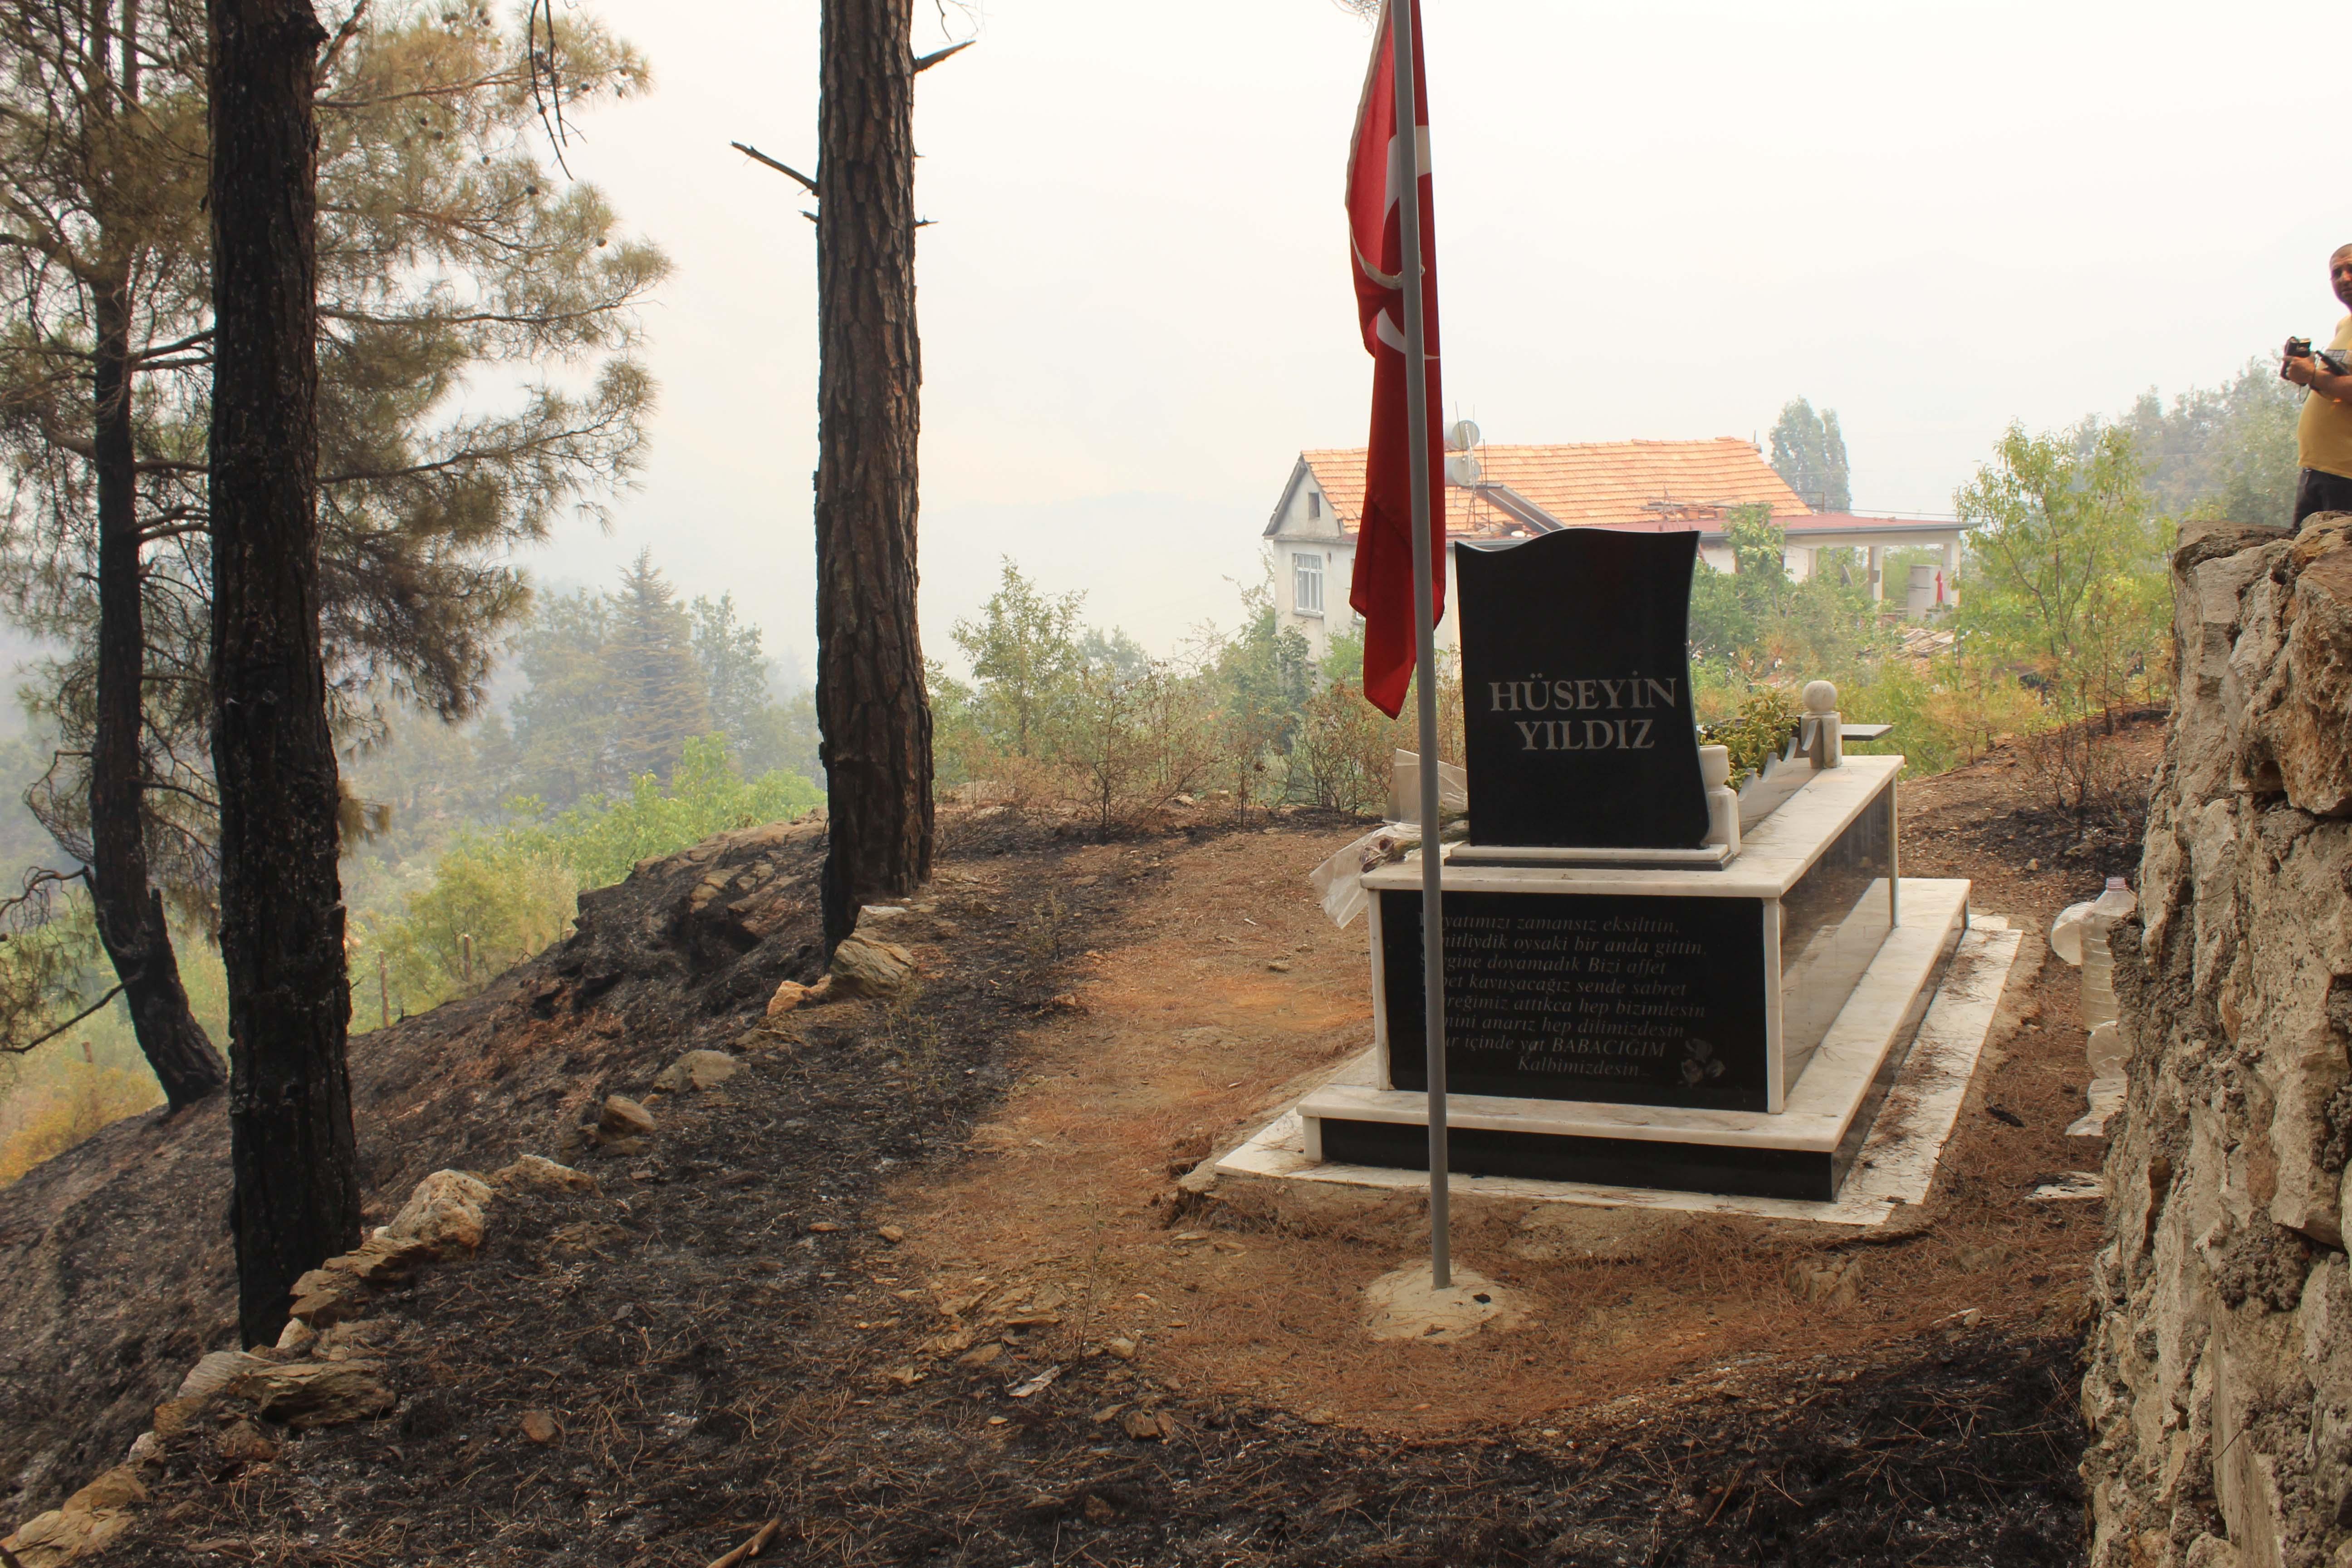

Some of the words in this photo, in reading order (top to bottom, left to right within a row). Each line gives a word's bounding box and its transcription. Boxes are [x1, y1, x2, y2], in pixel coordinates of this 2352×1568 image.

[1488, 671, 1677, 711] HÜSEYİN
[1514, 719, 1655, 750] YILDIZ
[1419, 911, 1510, 931] yatımızı
[1517, 917, 1597, 932] zamansız
[1419, 932, 1509, 952] itliydik
[1514, 935, 1568, 953] oysaki
[1575, 936, 1600, 951] bir
[1604, 937, 1648, 953] anda
[1654, 940, 1706, 958] gittin,
[1488, 952, 1581, 973] doyamadık
[1588, 956, 1623, 973] Bizi
[1626, 958, 1666, 979] affet
[1469, 973, 1571, 995] kavuşacağız
[1575, 978, 1626, 993] sende
[1631, 980, 1687, 996] sabret
[1421, 992, 1509, 1012] reğimiz
[1578, 998, 1609, 1017] hep
[1616, 999, 1706, 1017] bizimlesin
[1482, 1017, 1536, 1032] anarız
[1541, 1016, 1571, 1036] hep
[1577, 1018, 1684, 1038] dilimizdesin
[1465, 1035, 1514, 1051] içinde
[1518, 1039, 1545, 1054] yat
[1552, 1037, 1666, 1057] BABACIĞIM
